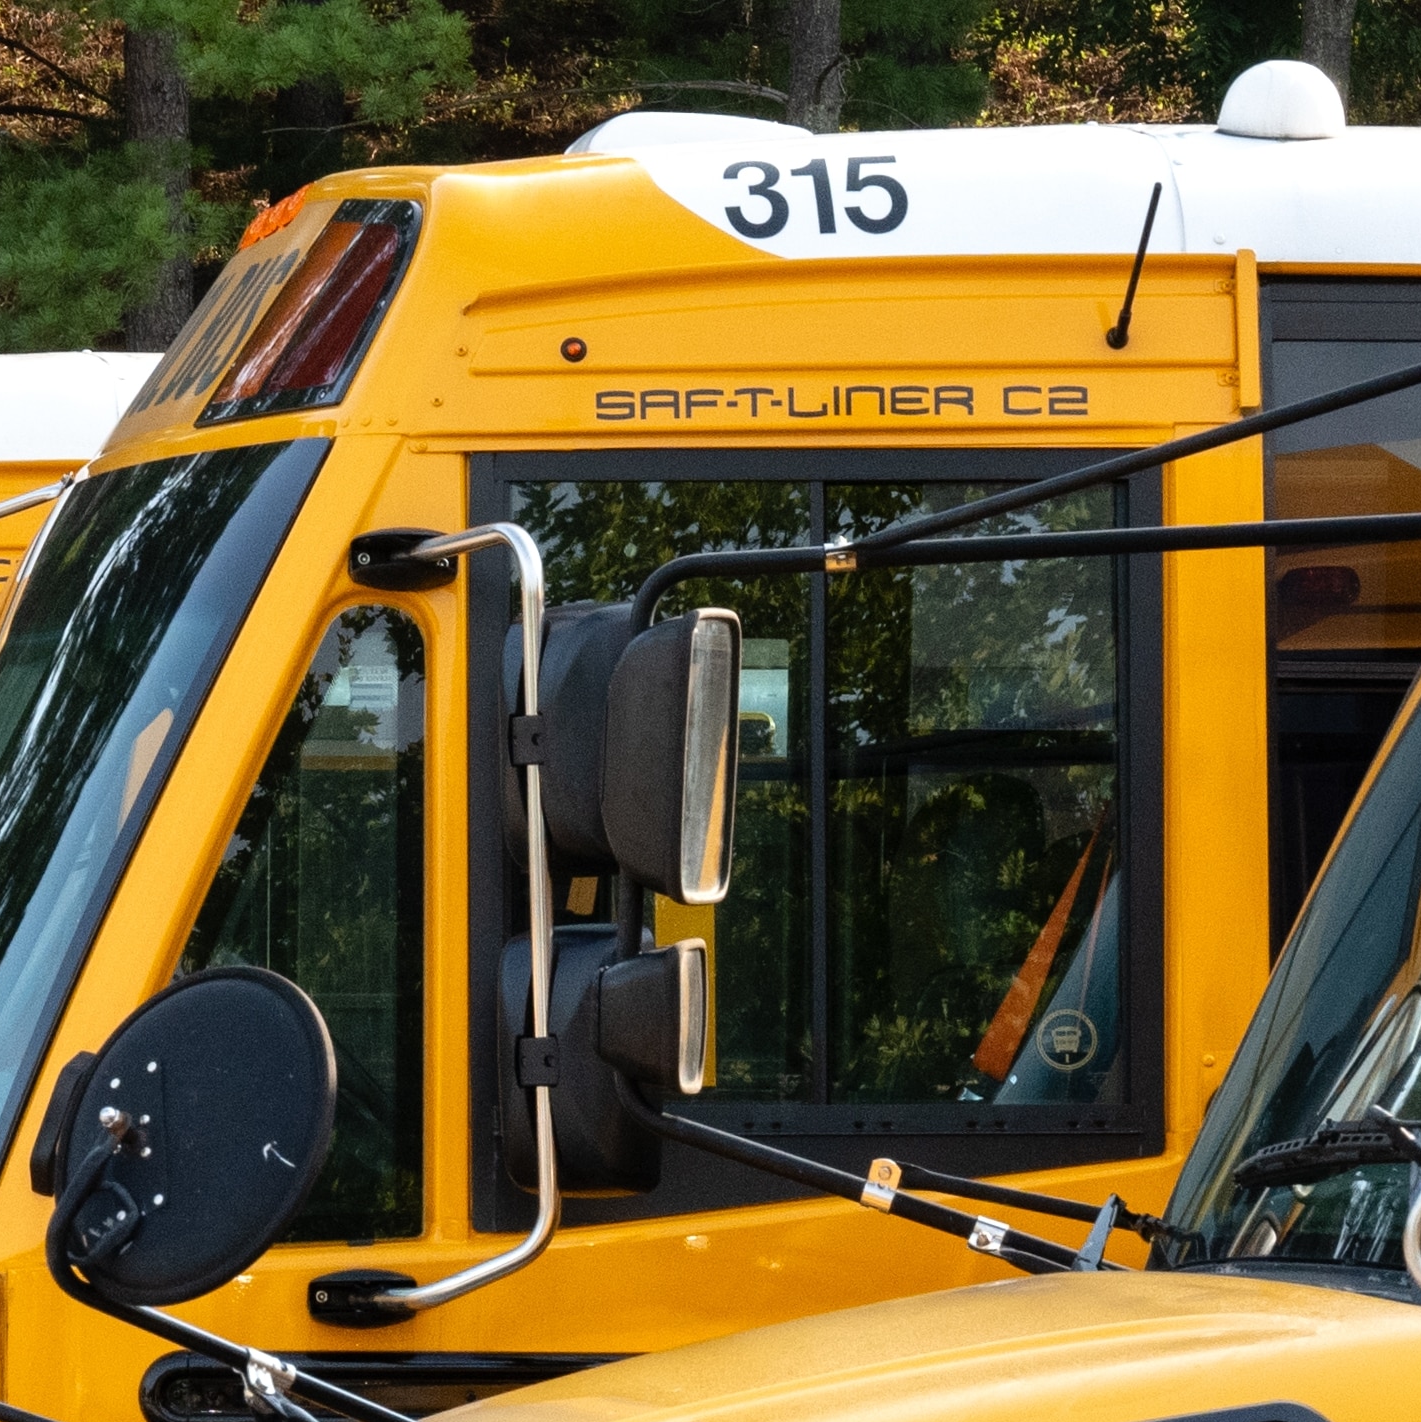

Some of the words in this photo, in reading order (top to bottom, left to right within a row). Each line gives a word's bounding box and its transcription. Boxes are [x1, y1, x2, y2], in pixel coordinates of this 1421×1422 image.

[723, 154, 908, 239] 315
[595, 385, 974, 421] SAF-T-LINER
[1003, 385, 1088, 416] C2
